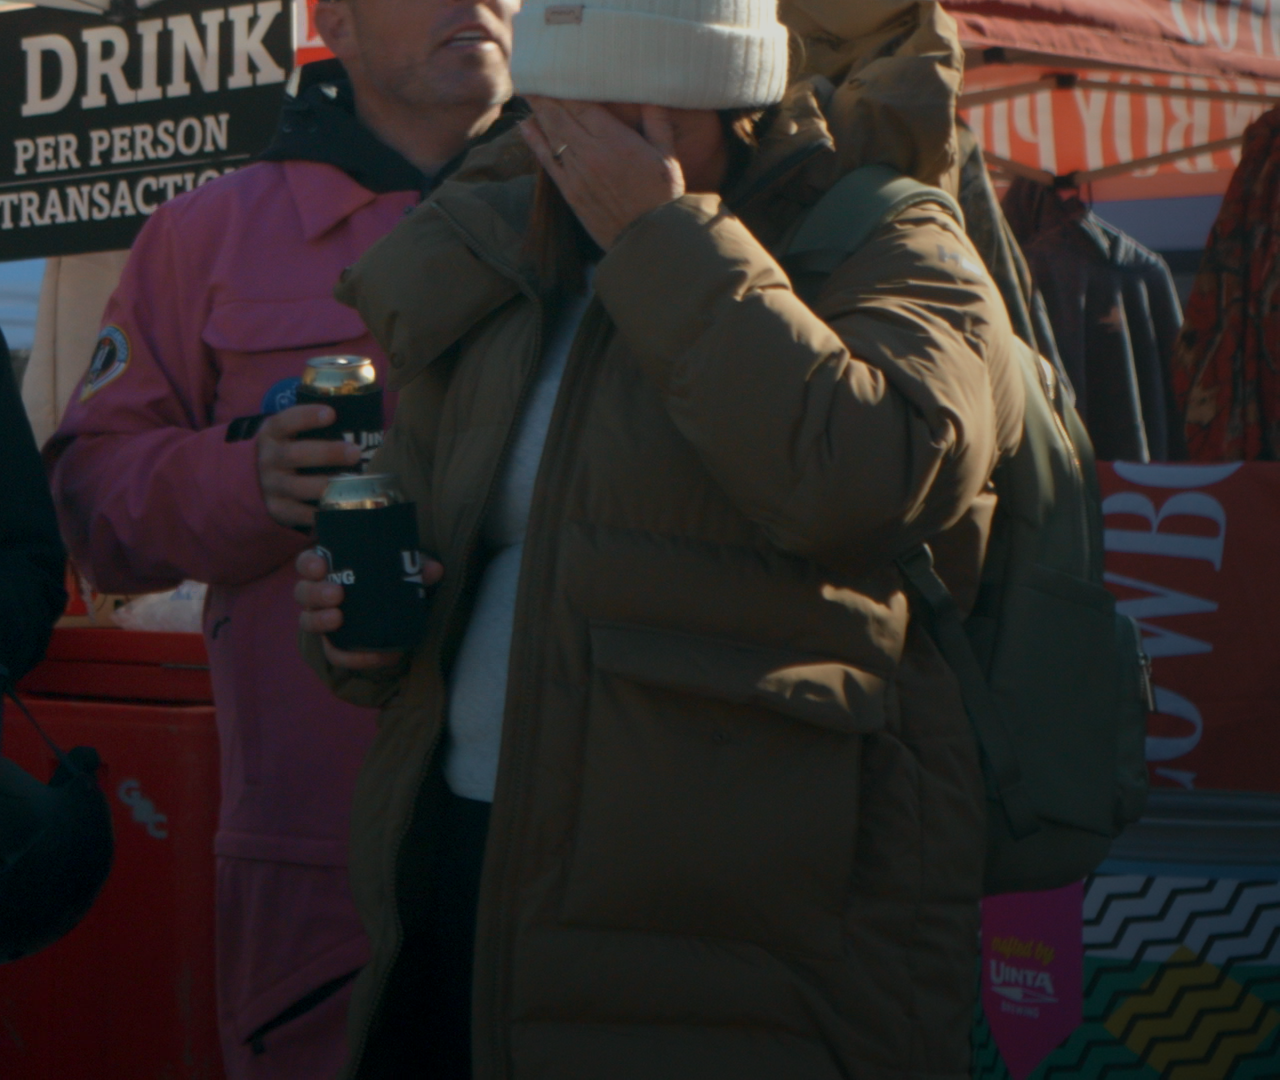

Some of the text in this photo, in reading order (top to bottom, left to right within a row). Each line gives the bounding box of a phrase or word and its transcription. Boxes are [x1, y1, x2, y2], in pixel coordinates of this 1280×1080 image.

[21, 0, 286, 118] DRINK
[14, 113, 230, 175] PER PERSON
[989, 958, 1056, 997] UINTA
